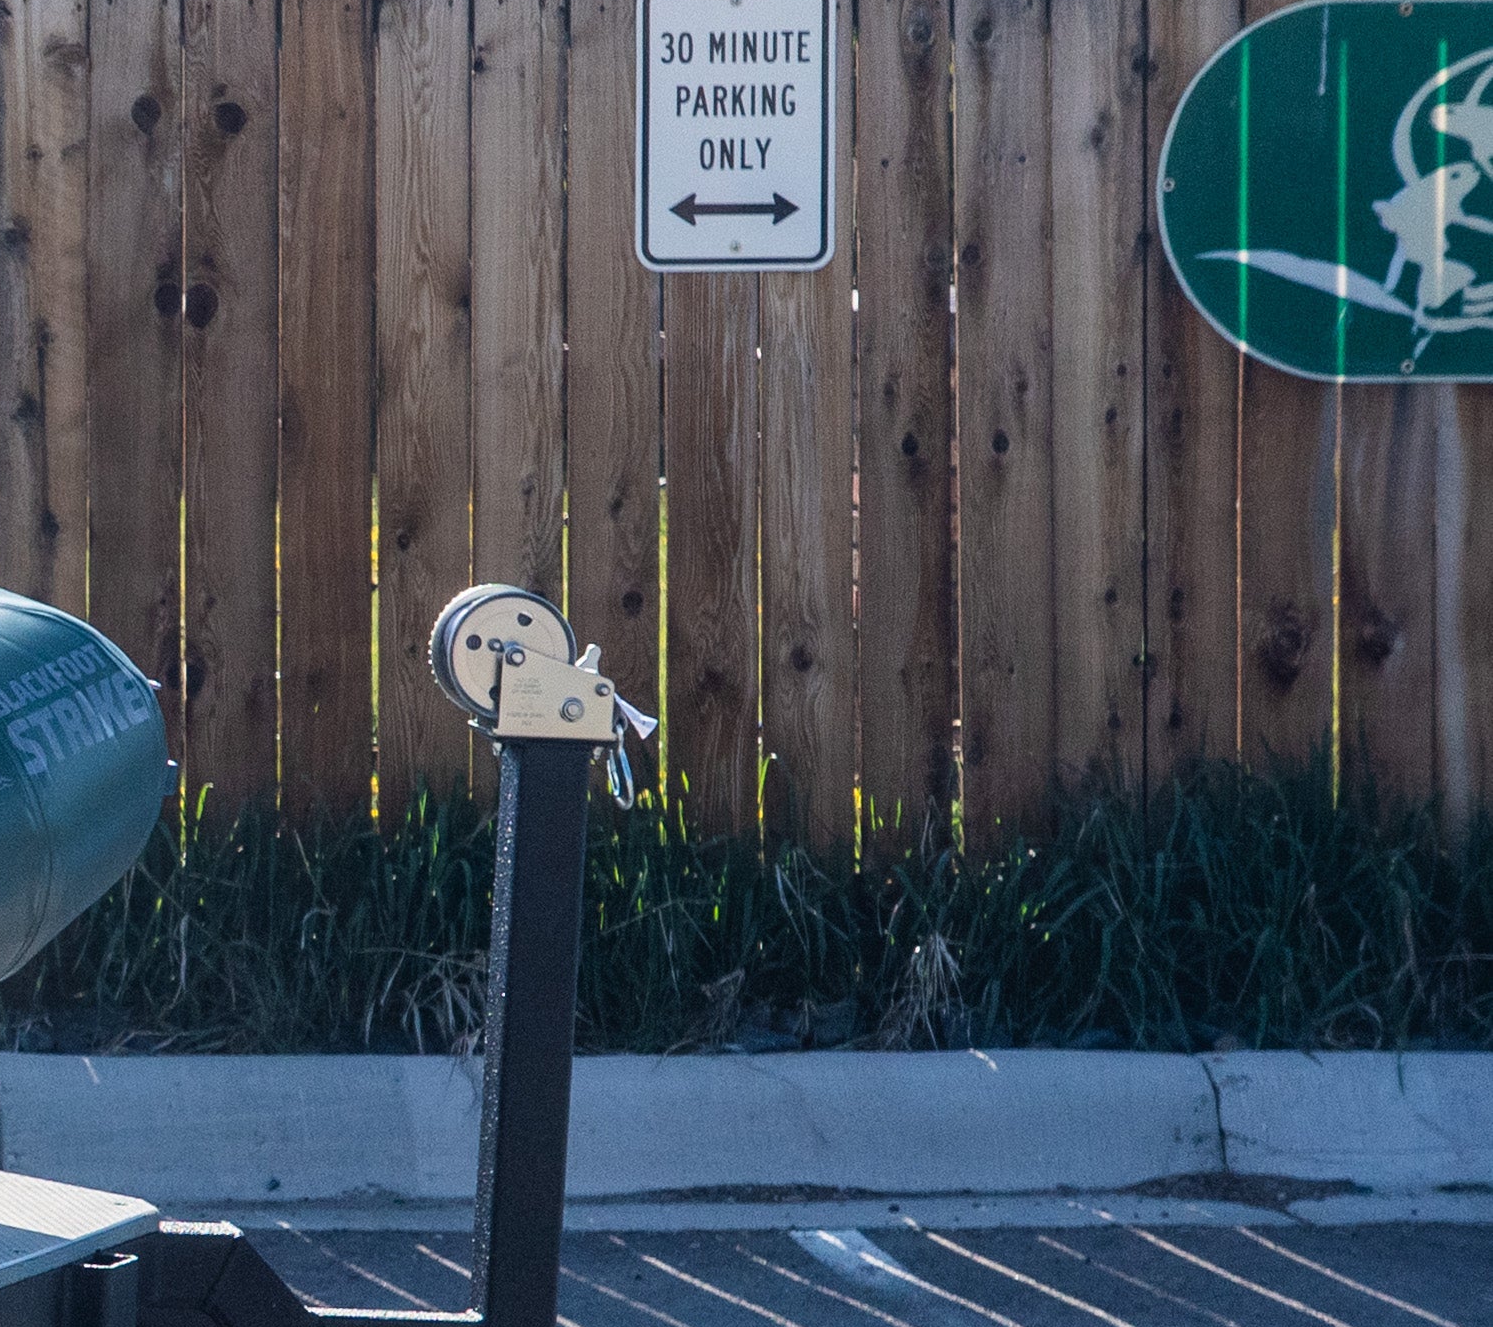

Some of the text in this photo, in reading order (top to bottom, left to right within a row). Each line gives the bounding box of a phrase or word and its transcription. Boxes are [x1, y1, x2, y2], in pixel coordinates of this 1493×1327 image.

[660, 30, 811, 64] 30 MINUTE
[675, 84, 796, 117] PARKING
[699, 137, 772, 171] ONLY
[6, 671, 152, 777] STRIKE
